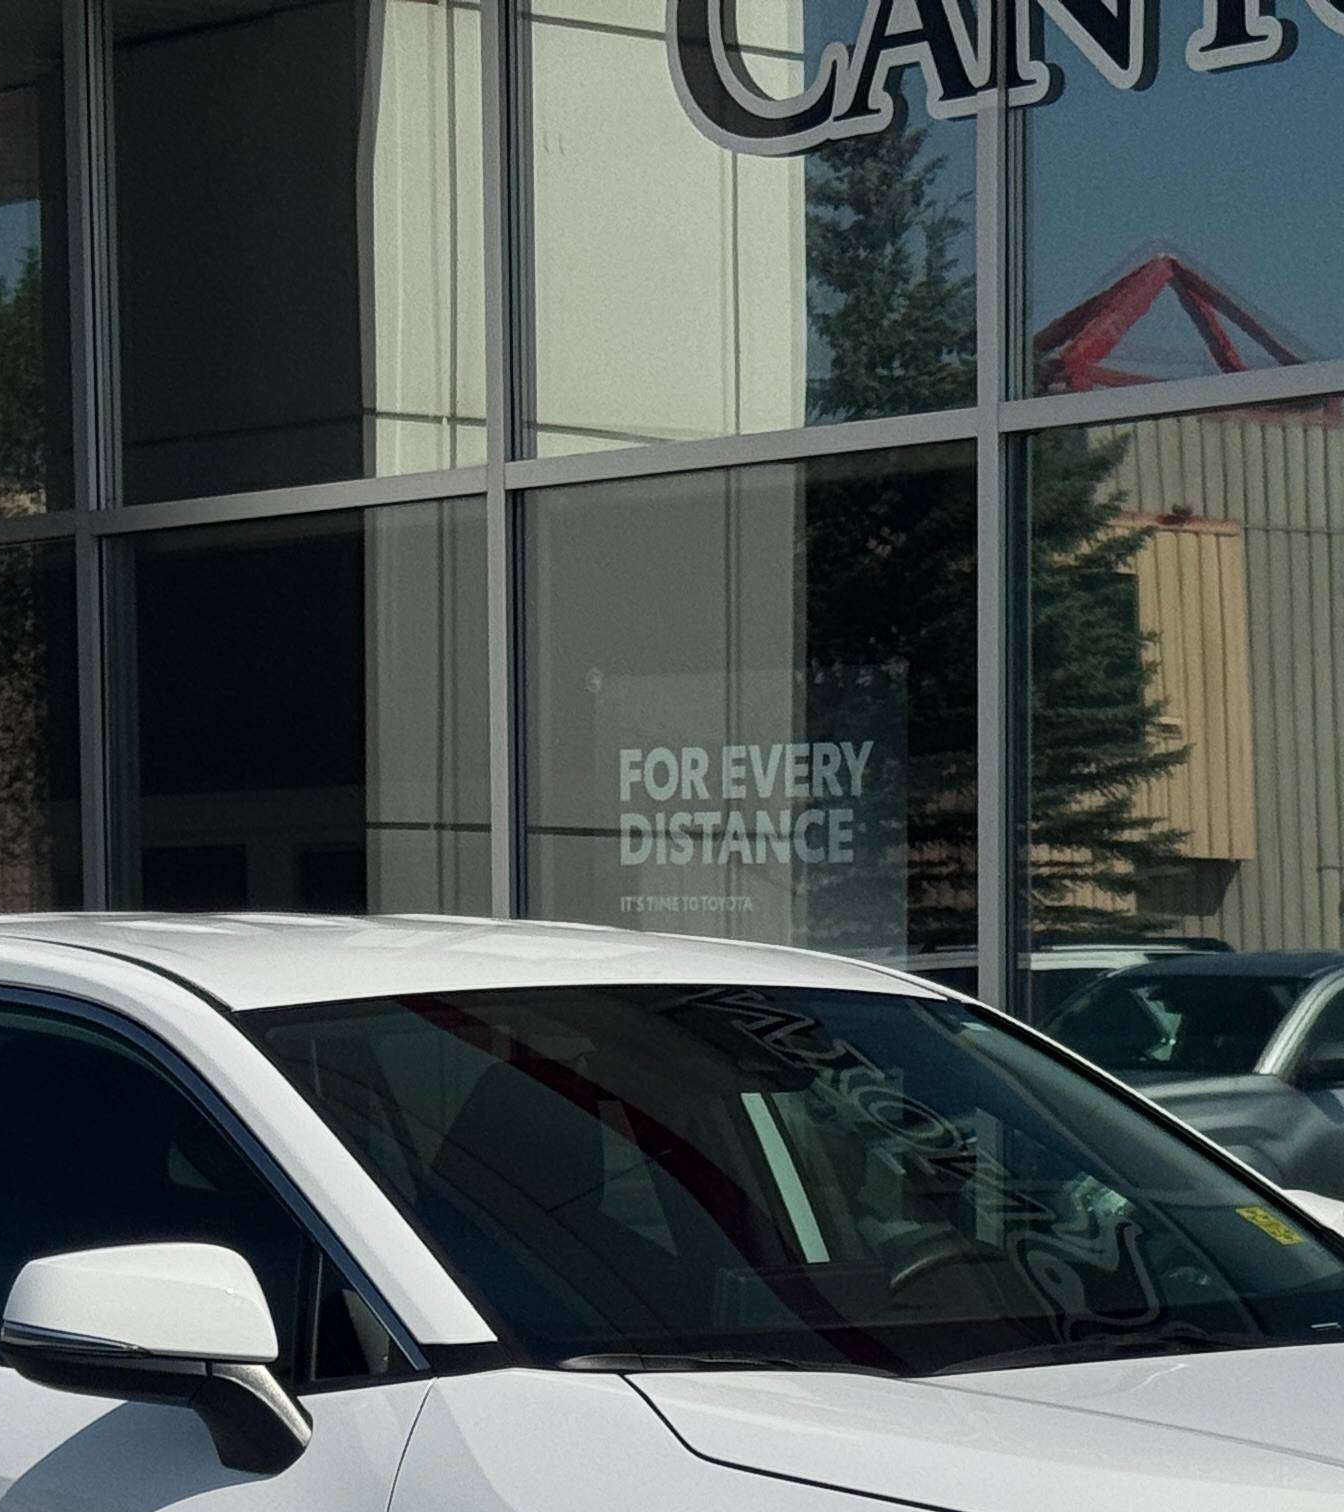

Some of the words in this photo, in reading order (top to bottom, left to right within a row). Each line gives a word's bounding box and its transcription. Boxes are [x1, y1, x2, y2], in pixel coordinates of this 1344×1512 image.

[619, 747, 710, 801] FOR
[721, 740, 874, 800] EVERY
[619, 808, 855, 867] DISTANCE
